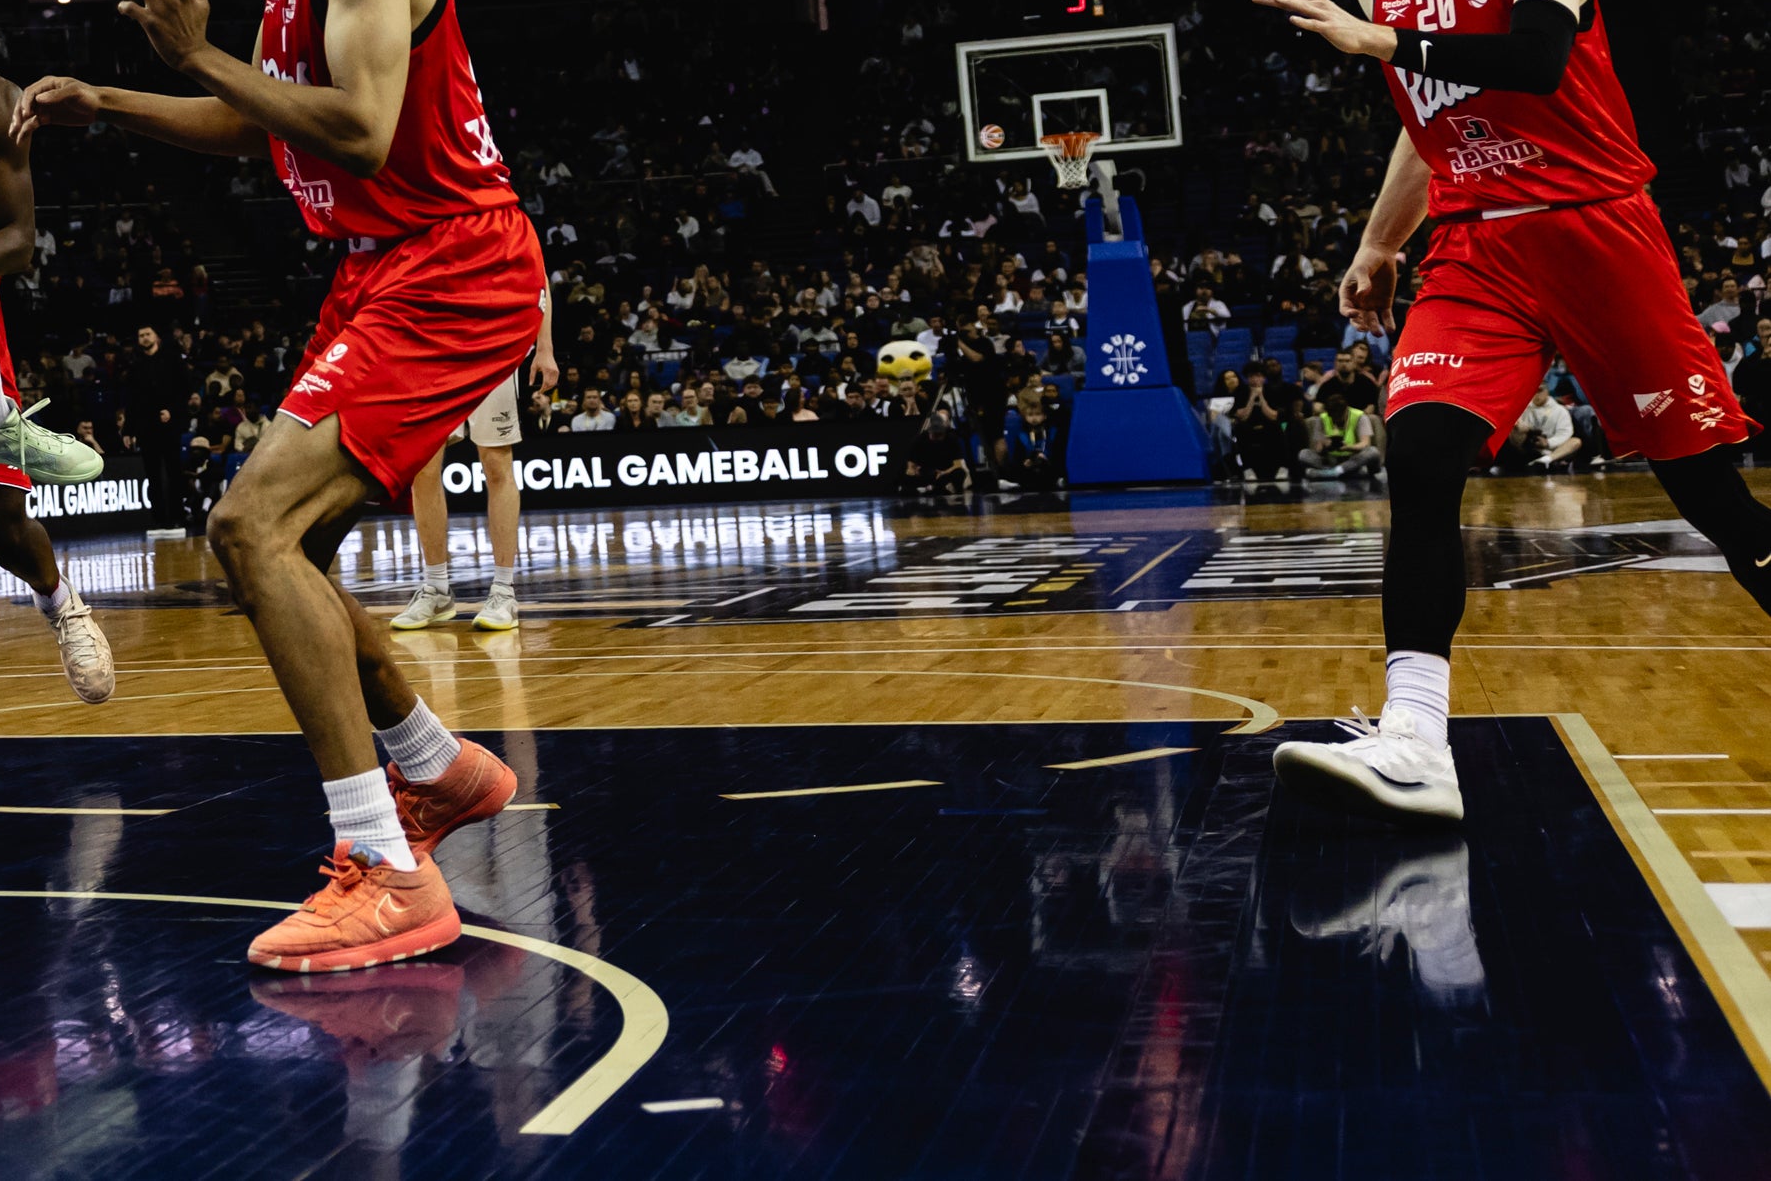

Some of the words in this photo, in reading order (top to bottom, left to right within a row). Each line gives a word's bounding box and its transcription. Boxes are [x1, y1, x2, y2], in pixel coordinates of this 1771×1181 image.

[1446, 138, 1544, 174] Jelson
[1402, 352, 1464, 368] VERTU
[442, 456, 612, 494] OFICIAL
[618, 448, 828, 486] GAMEBALL
[834, 444, 889, 477] OF
[64, 479, 142, 515] GAMEBALL
